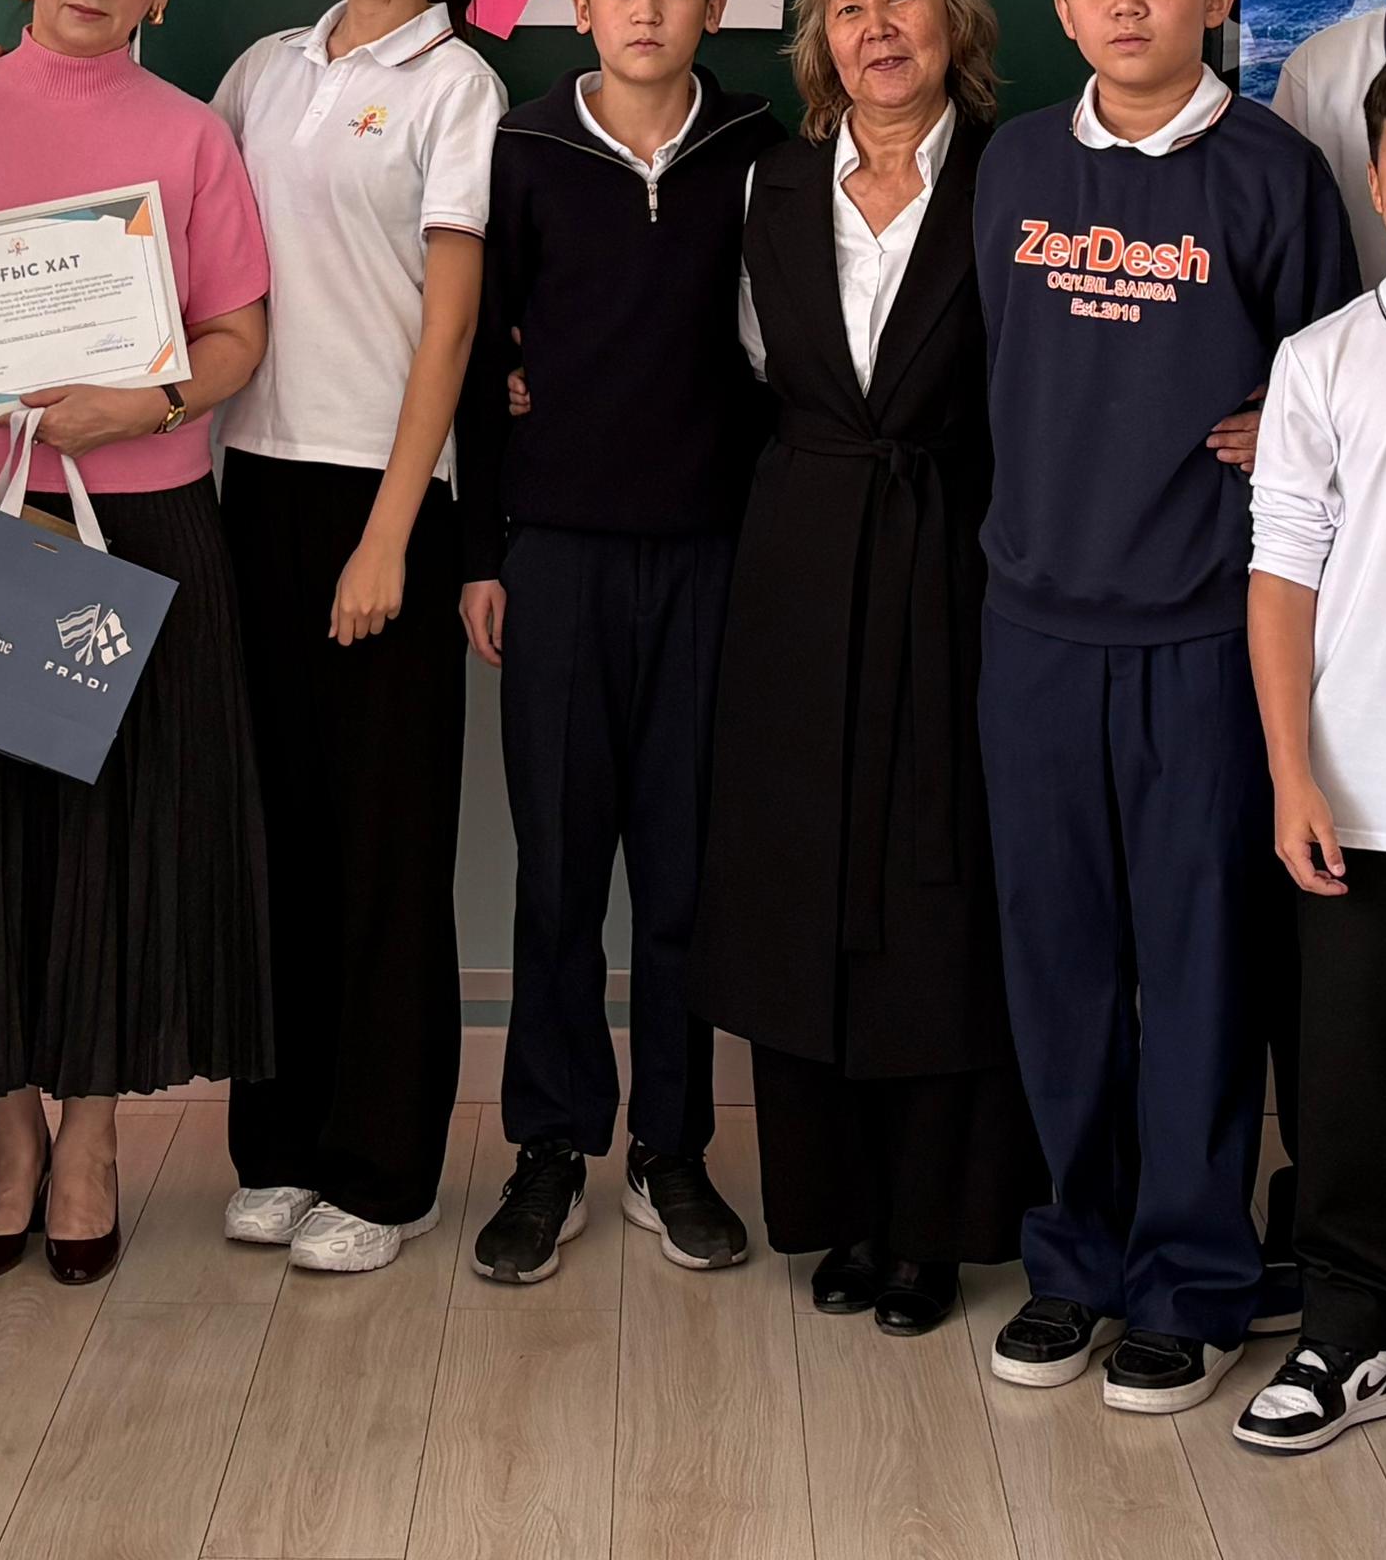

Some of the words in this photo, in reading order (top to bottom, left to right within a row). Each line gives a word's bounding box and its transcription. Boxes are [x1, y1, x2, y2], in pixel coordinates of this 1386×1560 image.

[45, 254, 81, 274] ХАТ
[1015, 219, 1210, 284] ZerDesh
[44, 660, 109, 693] FRADI
